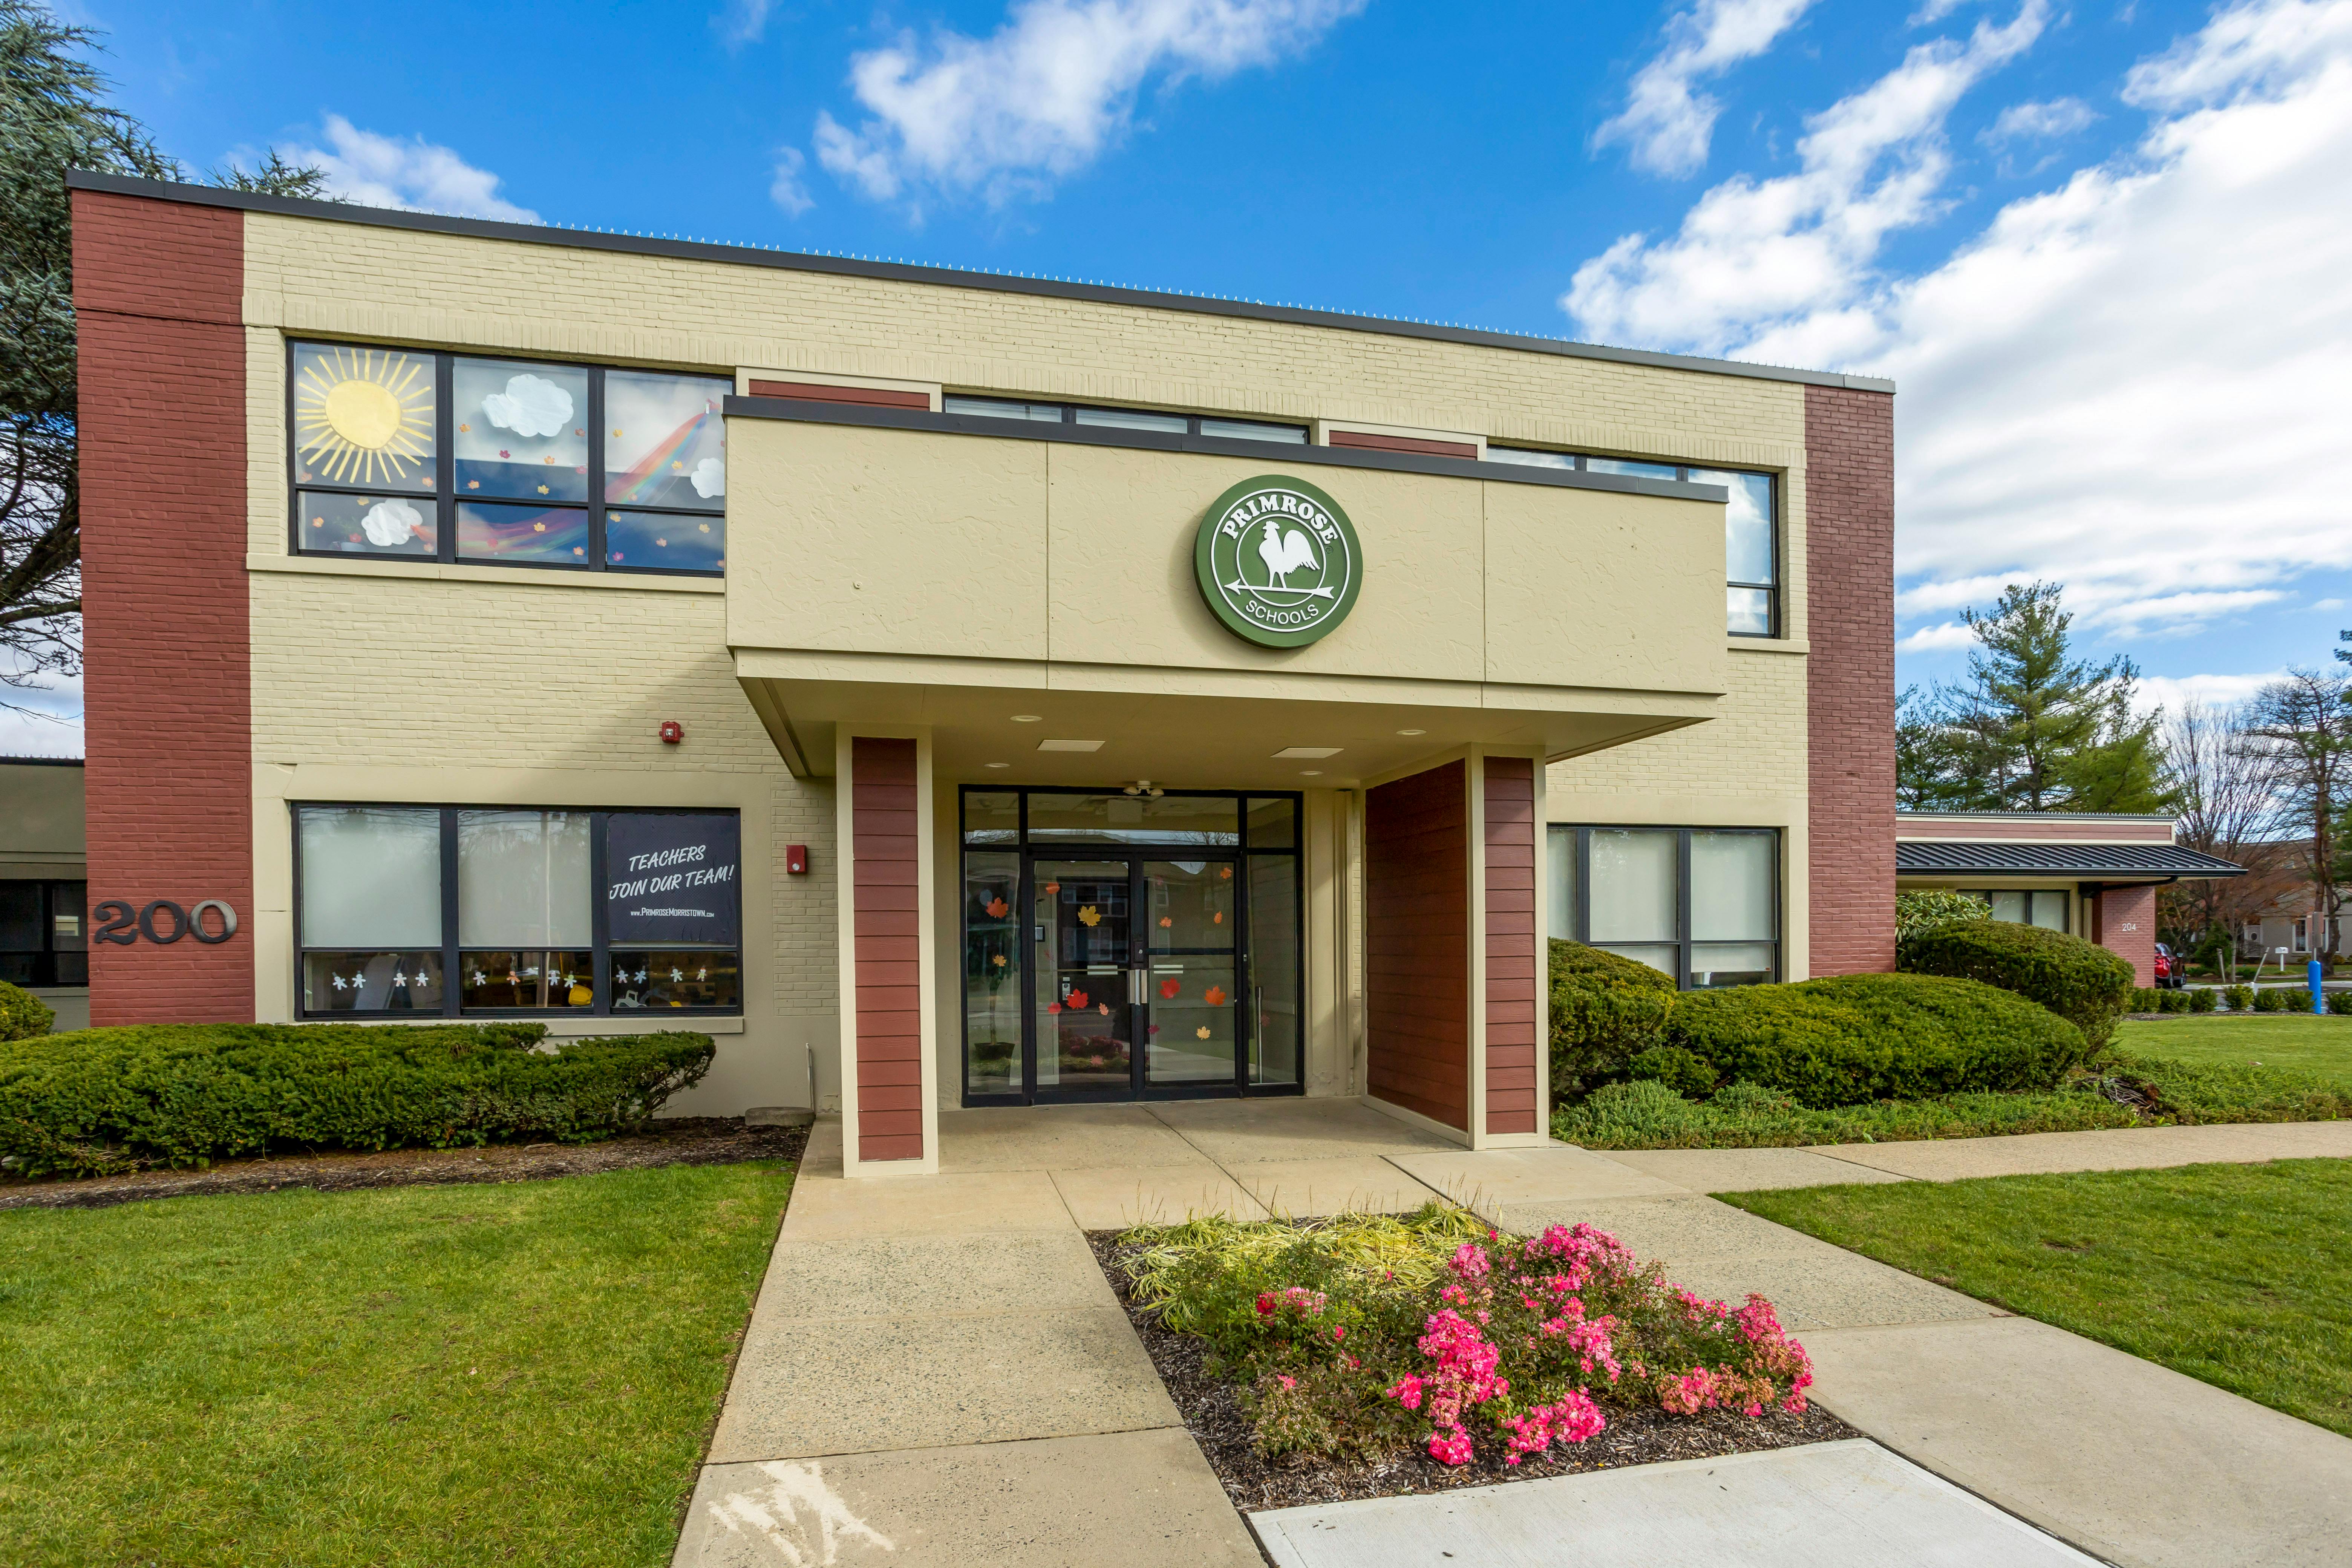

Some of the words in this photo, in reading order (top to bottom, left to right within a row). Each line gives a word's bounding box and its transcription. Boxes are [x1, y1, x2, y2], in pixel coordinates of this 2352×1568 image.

[1222, 494, 1338, 544] PRIMROSE
[1245, 600, 1319, 624] SCHOOLS
[629, 845, 706, 871] TEACHERS
[609, 879, 648, 899] JOIN
[650, 874, 681, 893] OUR
[685, 865, 734, 887] TEAM!
[94, 900, 237, 944] 200
